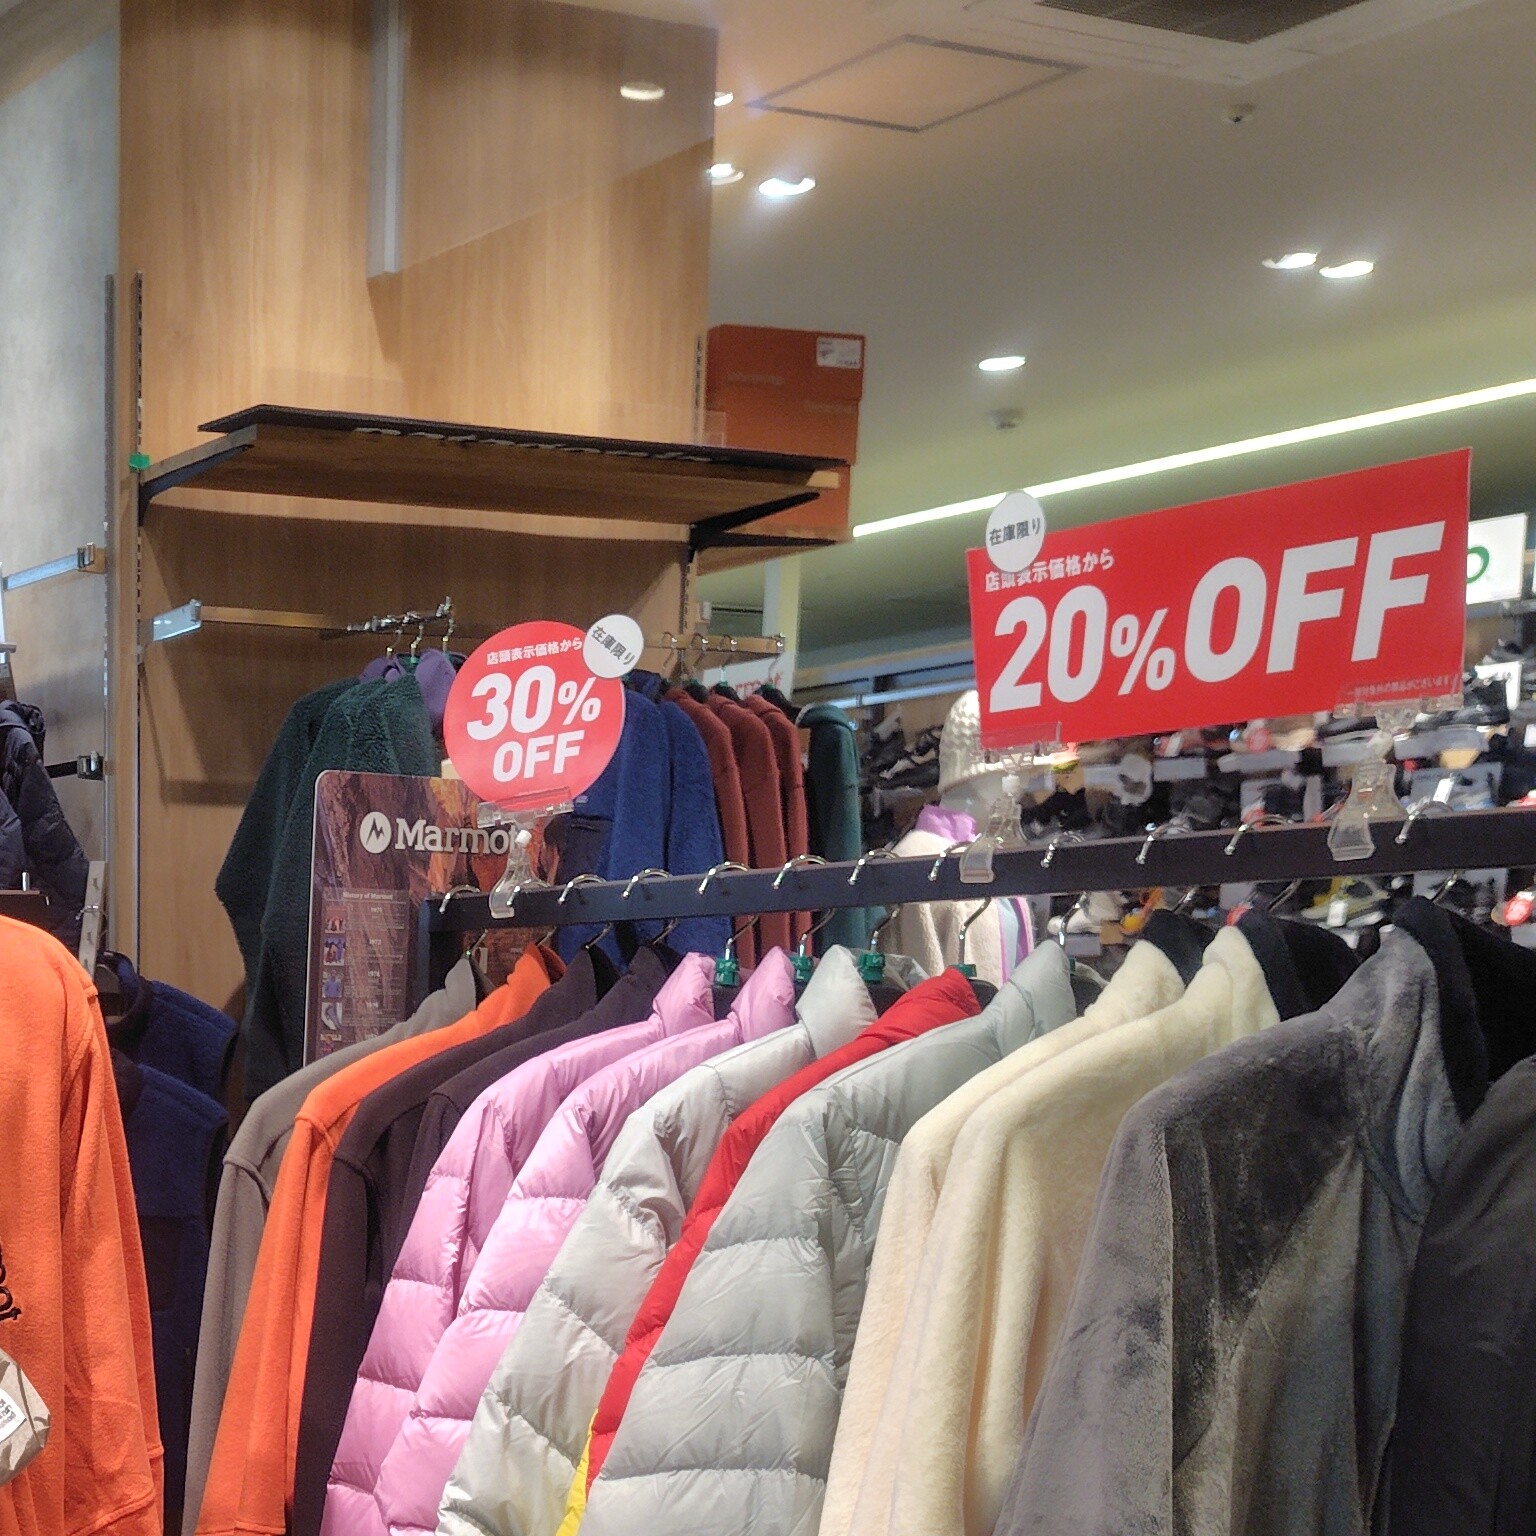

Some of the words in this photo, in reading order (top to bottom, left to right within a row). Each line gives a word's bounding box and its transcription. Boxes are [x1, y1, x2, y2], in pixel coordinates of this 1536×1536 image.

[988, 516, 1042, 547] 在庫限り
[989, 520, 1446, 714] 20%OFF
[485, 636, 583, 666] 店頭表示価格から
[589, 624, 637, 666] 在庫限り
[466, 665, 602, 741] 30%
[492, 729, 585, 782] OFF
[394, 817, 517, 855] Marmot
